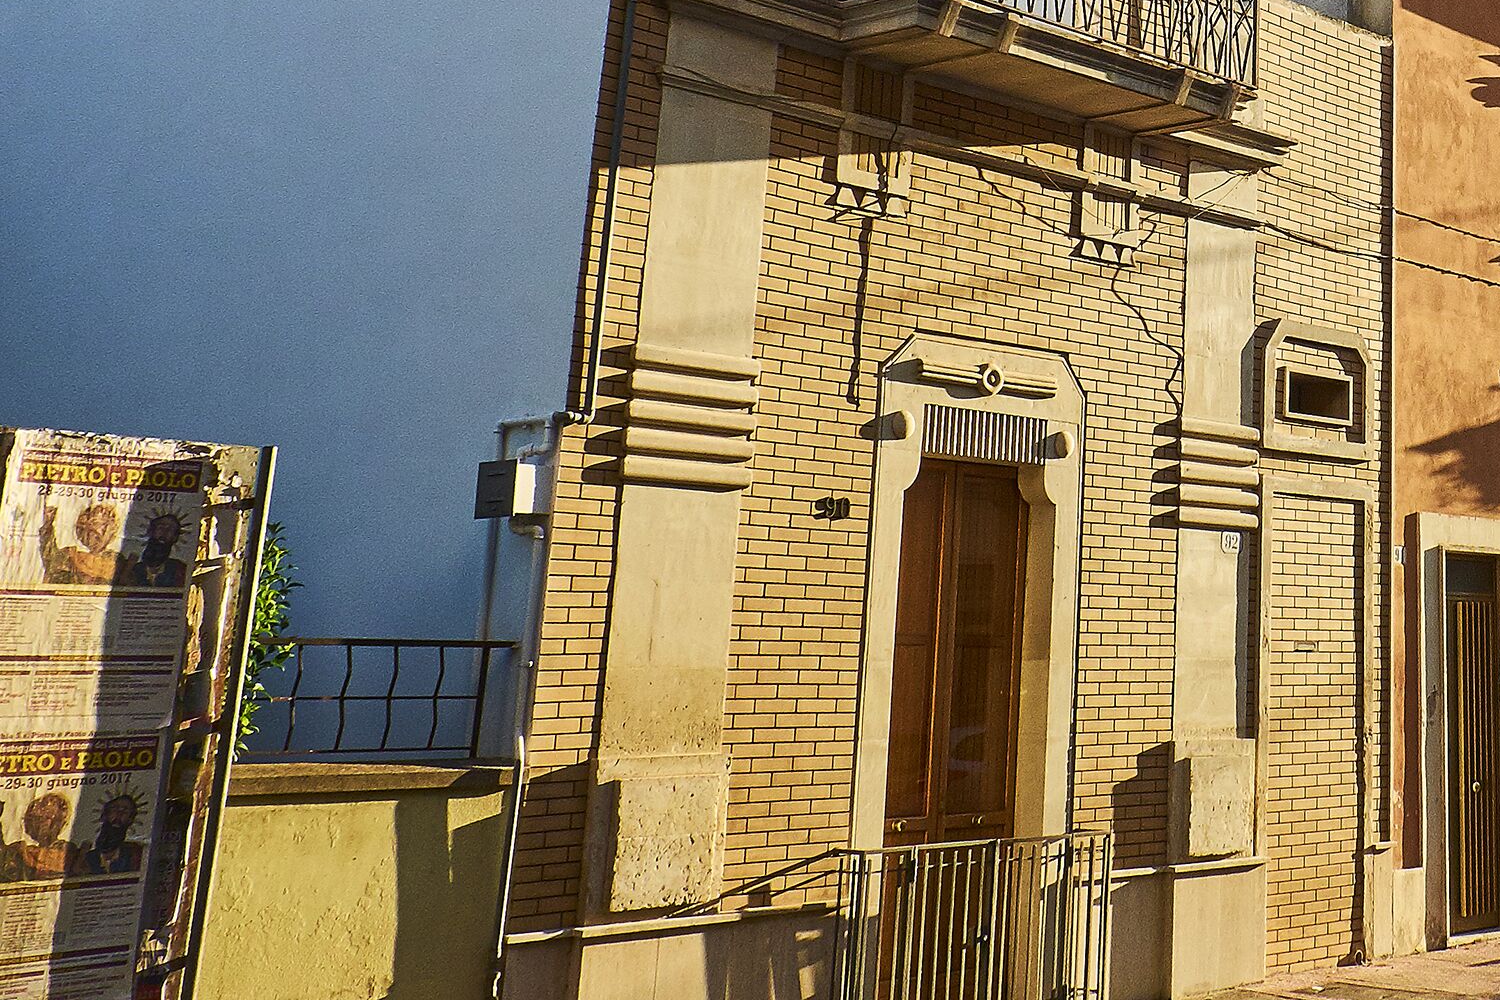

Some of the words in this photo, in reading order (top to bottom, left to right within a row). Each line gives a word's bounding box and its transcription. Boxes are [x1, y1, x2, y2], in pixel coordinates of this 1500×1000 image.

[20, 463, 106, 484] PIETRO
[126, 468, 197, 488] PAOLO
[38, 485, 93, 499] 28-29-30
[98, 487, 143, 501] giugno
[149, 491, 177, 503] 2017
[1224, 534, 1238, 550] 92
[76, 750, 153, 770] PAOLO
[47, 776, 97, 791] giugno
[101, 772, 132, 785] 2017
